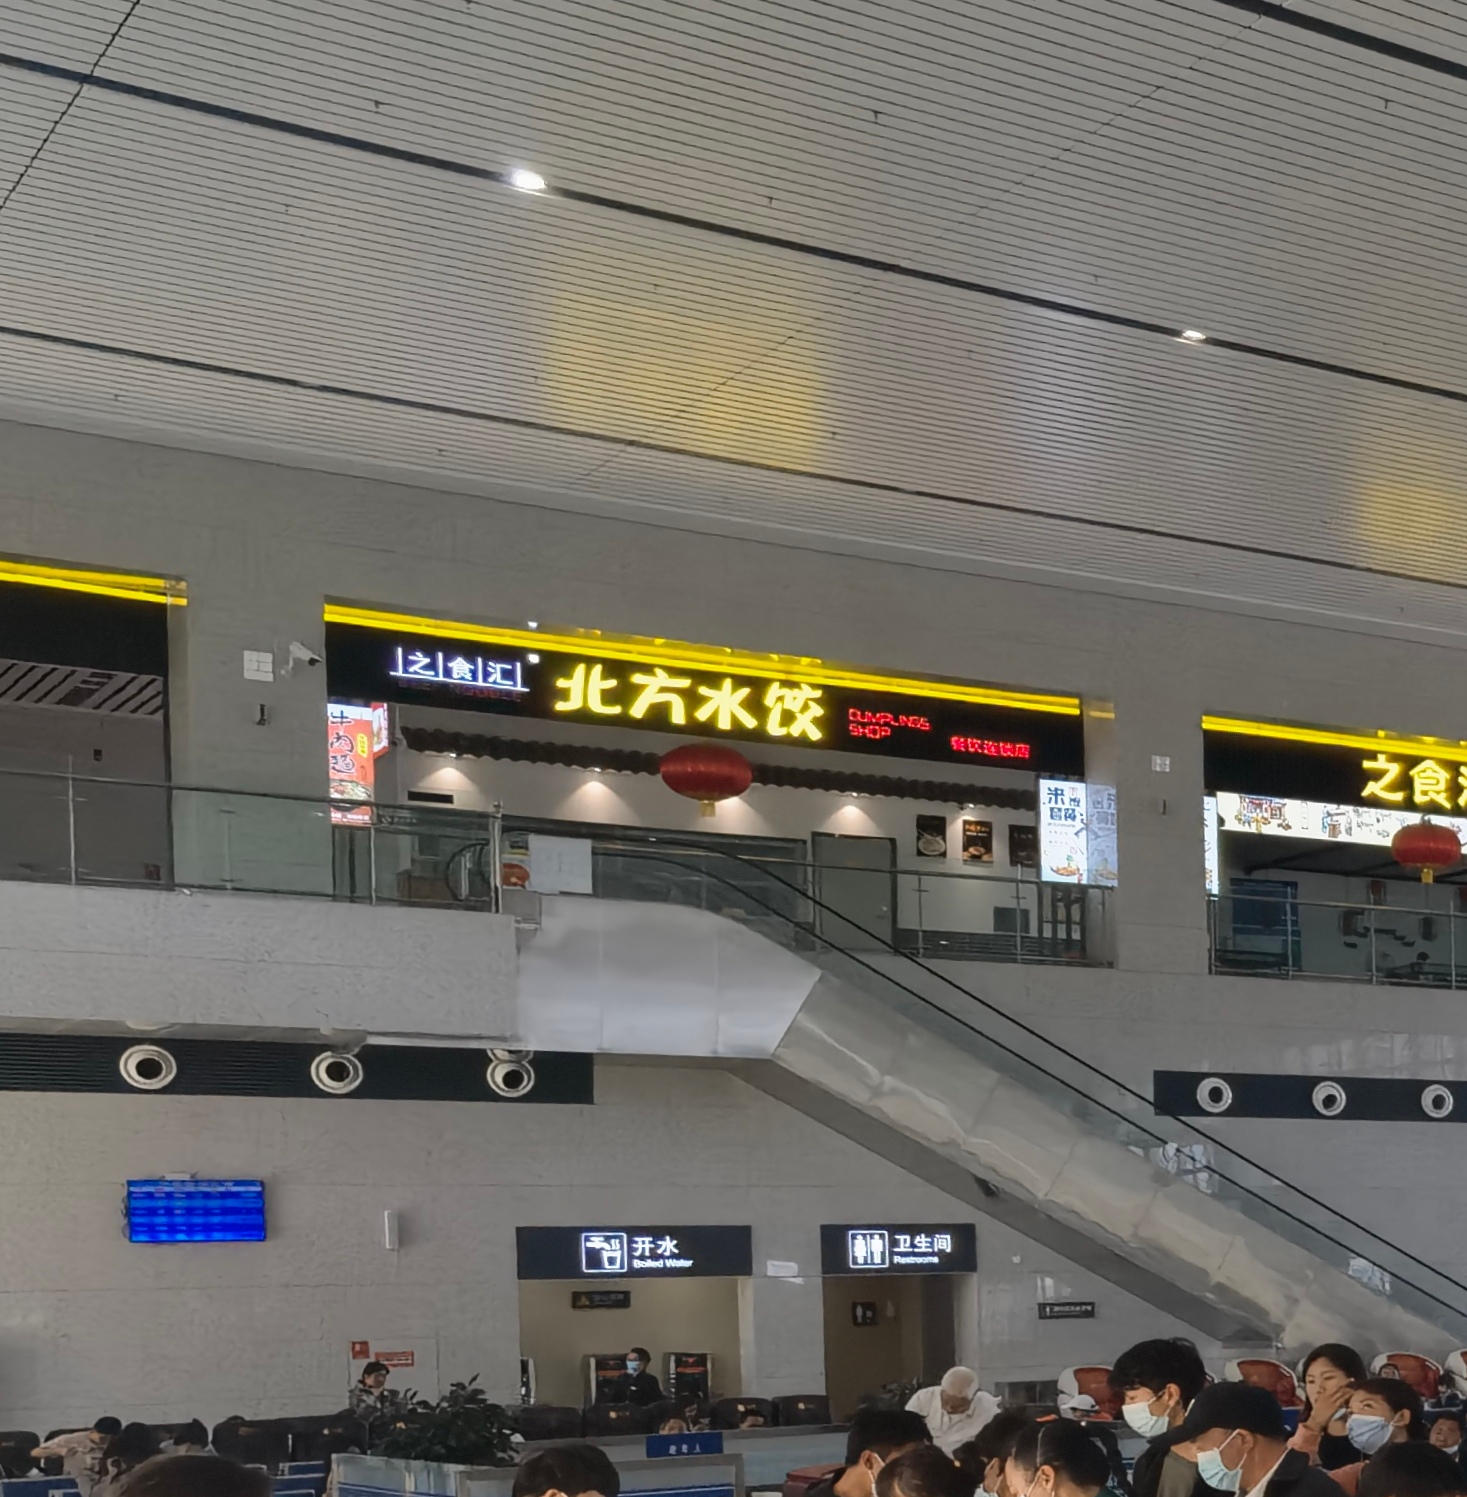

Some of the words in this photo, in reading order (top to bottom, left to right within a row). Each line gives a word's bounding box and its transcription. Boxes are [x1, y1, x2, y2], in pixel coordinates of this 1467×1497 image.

[405, 652, 514, 685] 之食汇
[554, 663, 824, 741] 北方水饺
[849, 708, 931, 731] DUMPLINGS
[849, 723, 891, 740] SHOP
[951, 736, 1030, 760] 餐饮连锁店
[632, 1236, 680, 1256] 开水
[893, 1235, 951, 1253] 卫生间
[633, 1259, 663, 1268] Boiled
[665, 1259, 694, 1268] Water
[893, 1256, 939, 1265] Restrooms
